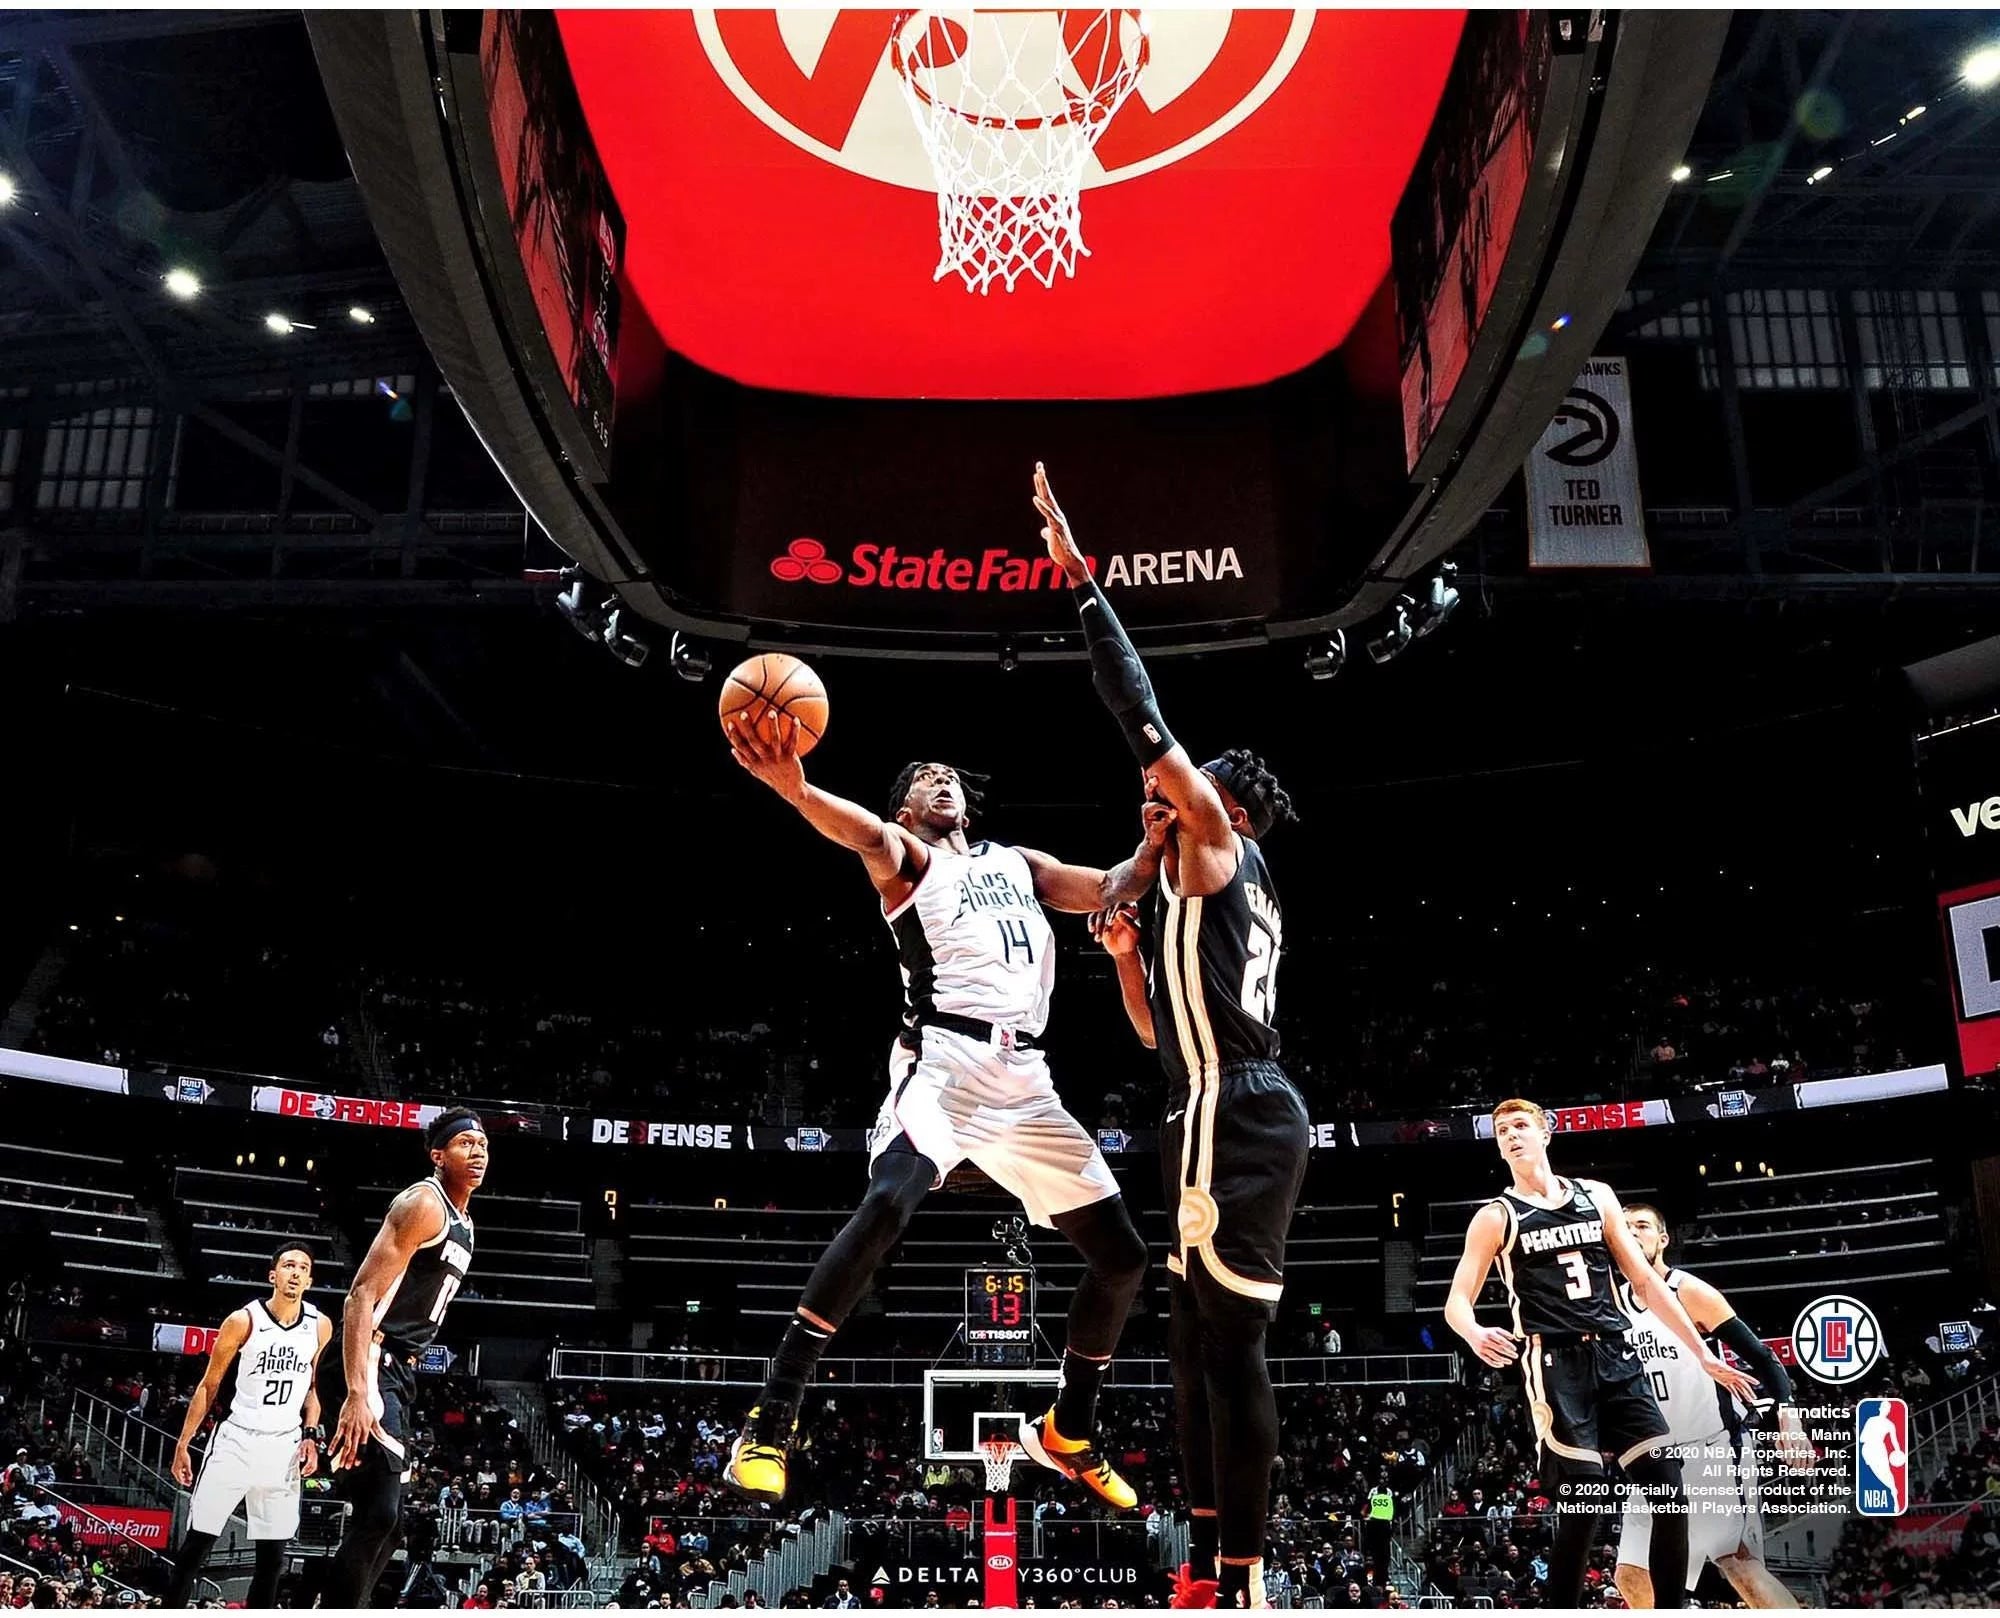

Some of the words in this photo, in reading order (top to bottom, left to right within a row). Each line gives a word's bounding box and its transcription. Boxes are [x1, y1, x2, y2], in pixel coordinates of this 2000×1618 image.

[1564, 479, 1600, 500] TED
[1549, 504, 1623, 526] TURNER
[1104, 547, 1244, 588] ARENA
[997, 920, 1034, 964] 14
[181, 1079, 202, 1088] BUILT
[1721, 1092, 1743, 1101] BUILT
[1556, 1101, 1646, 1131] FENSE
[800, 1129, 819, 1137] BUILT
[1101, 1131, 1119, 1139] BUILT
[985, 1275, 1024, 1293] 6:15
[1556, 1250, 1592, 1300] 3
[991, 1293, 1021, 1325] 13
[1630, 1329, 1653, 1347] Los
[1942, 1323, 1967, 1335] BUILT
[268, 1342, 295, 1359] Los
[1640, 1338, 1679, 1364] geles
[247, 1350, 309, 1378] Angeles
[263, 1380, 293, 1405] 20
[899, 1567, 979, 1583] DELTA
